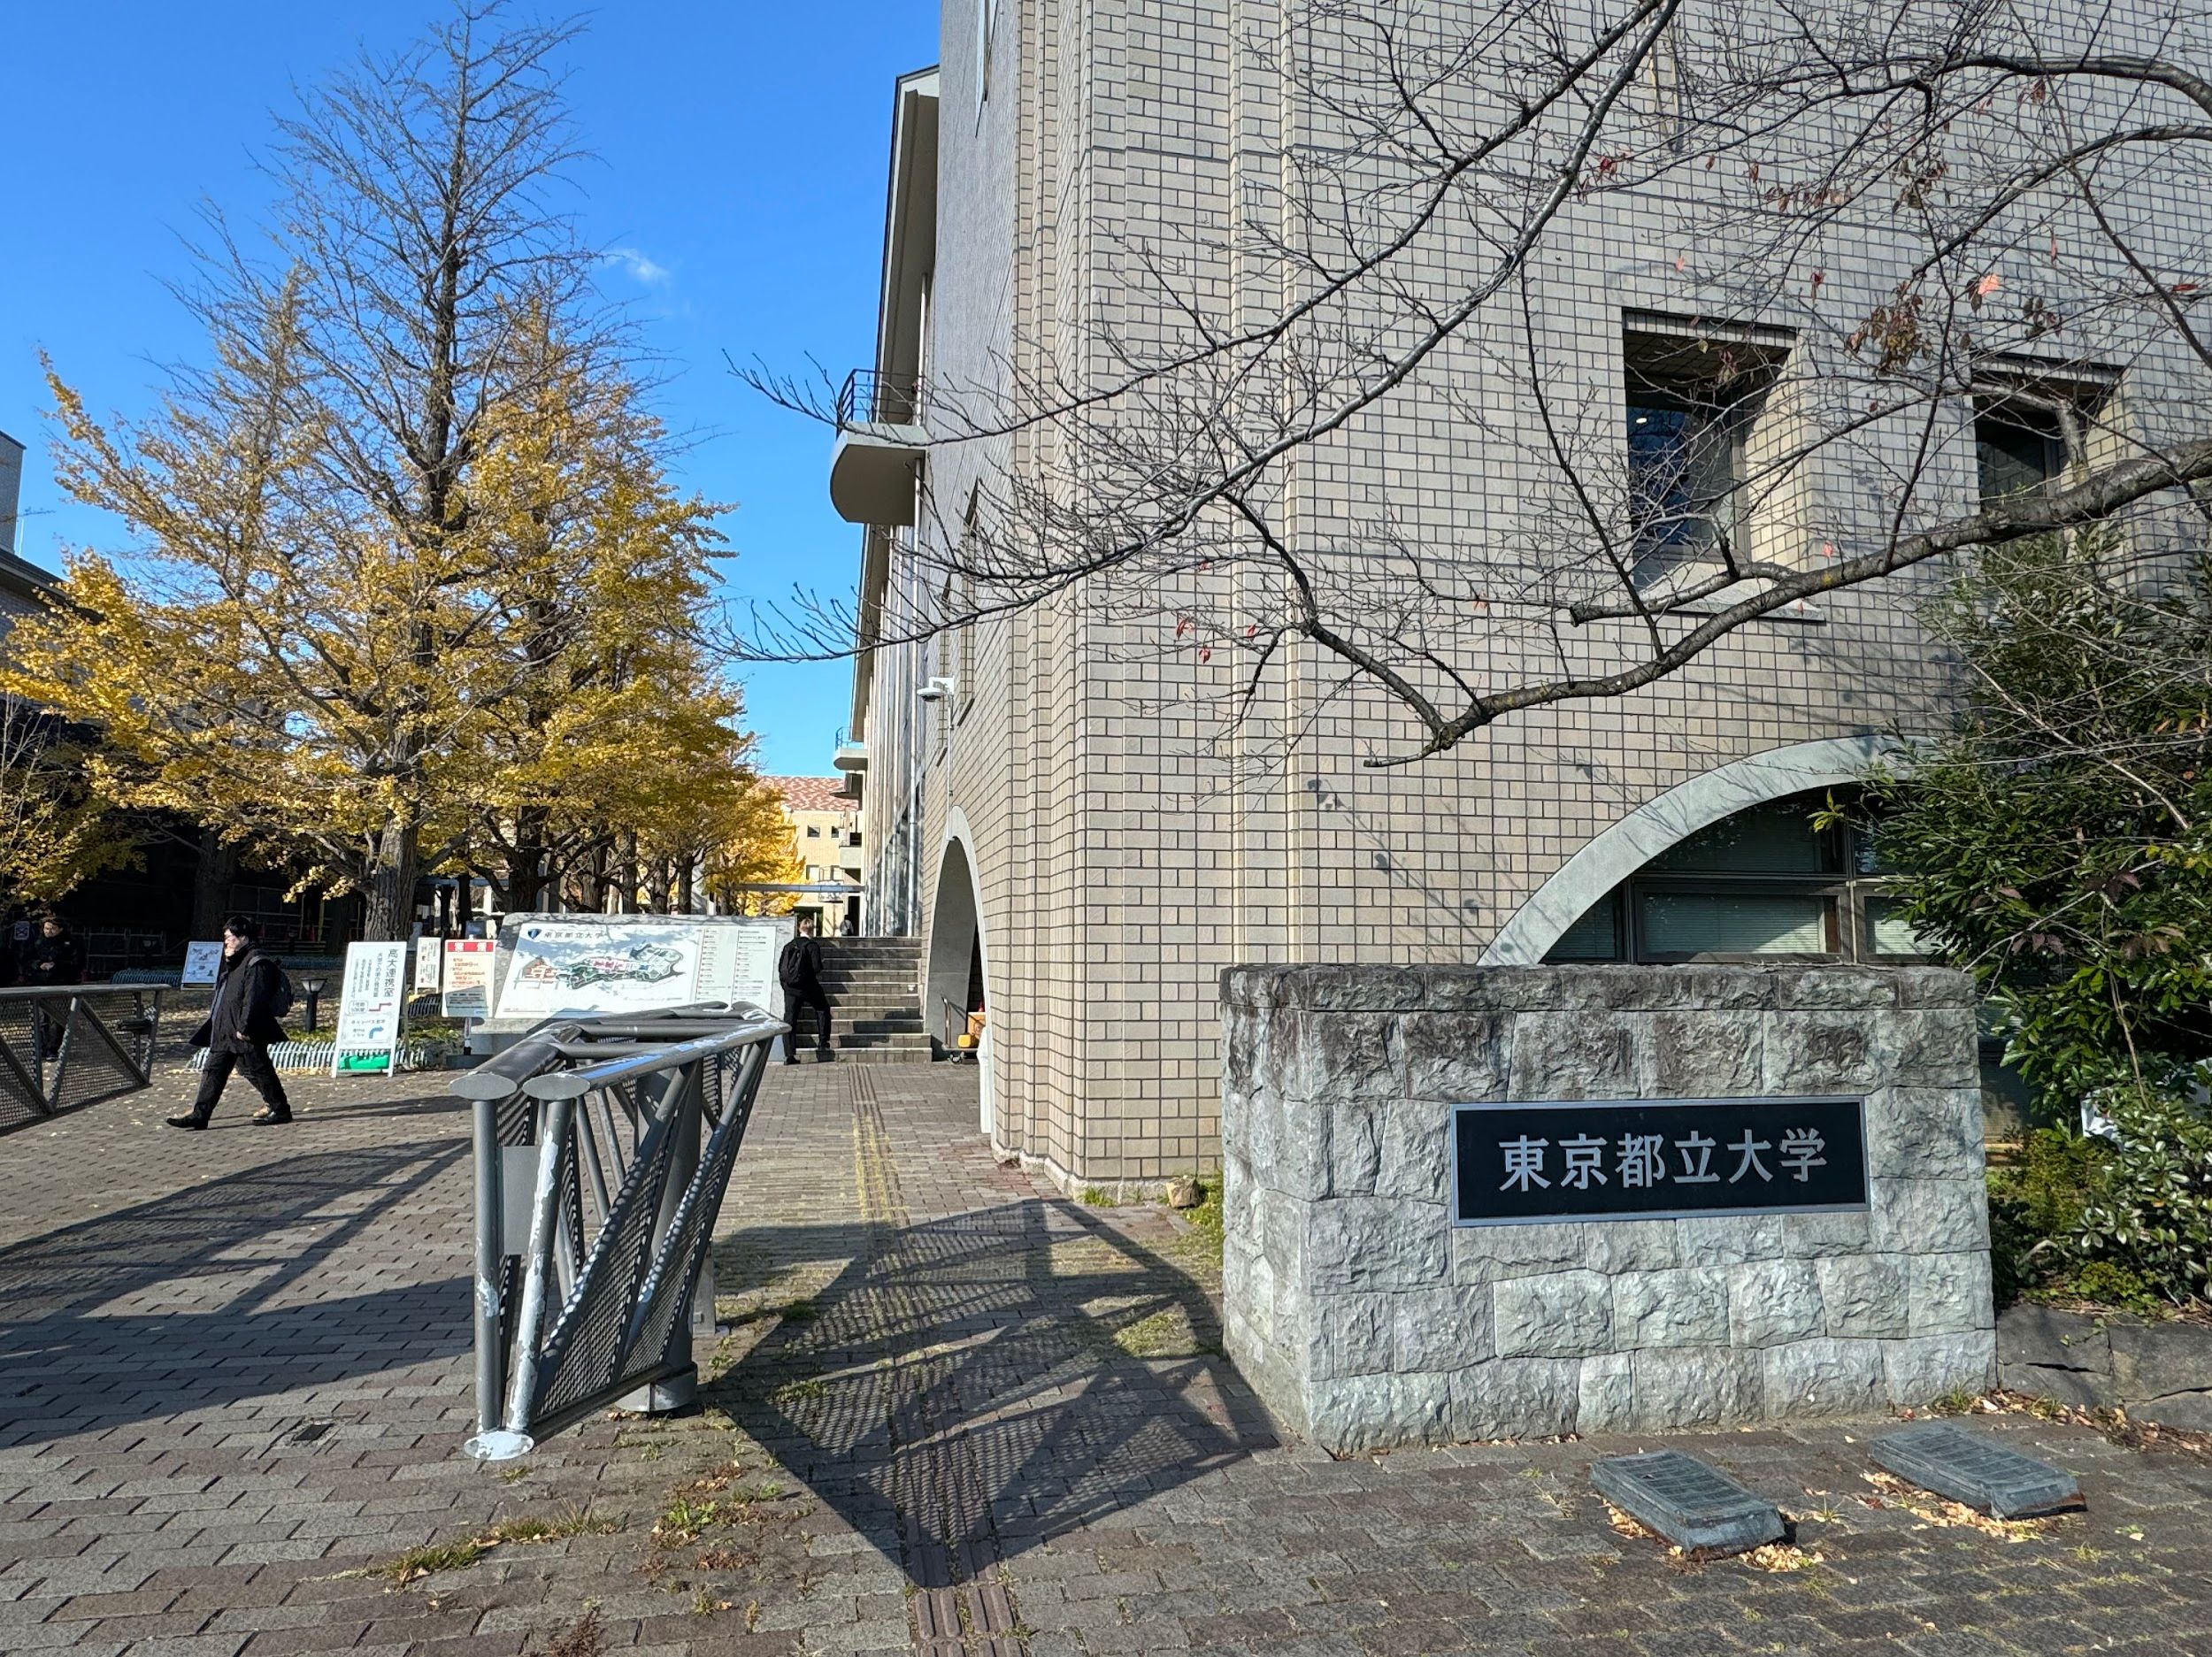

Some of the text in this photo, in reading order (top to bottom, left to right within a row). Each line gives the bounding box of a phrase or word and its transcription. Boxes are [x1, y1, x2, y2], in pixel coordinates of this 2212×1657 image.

[1498, 1128, 1828, 1193] 東京都立大学
